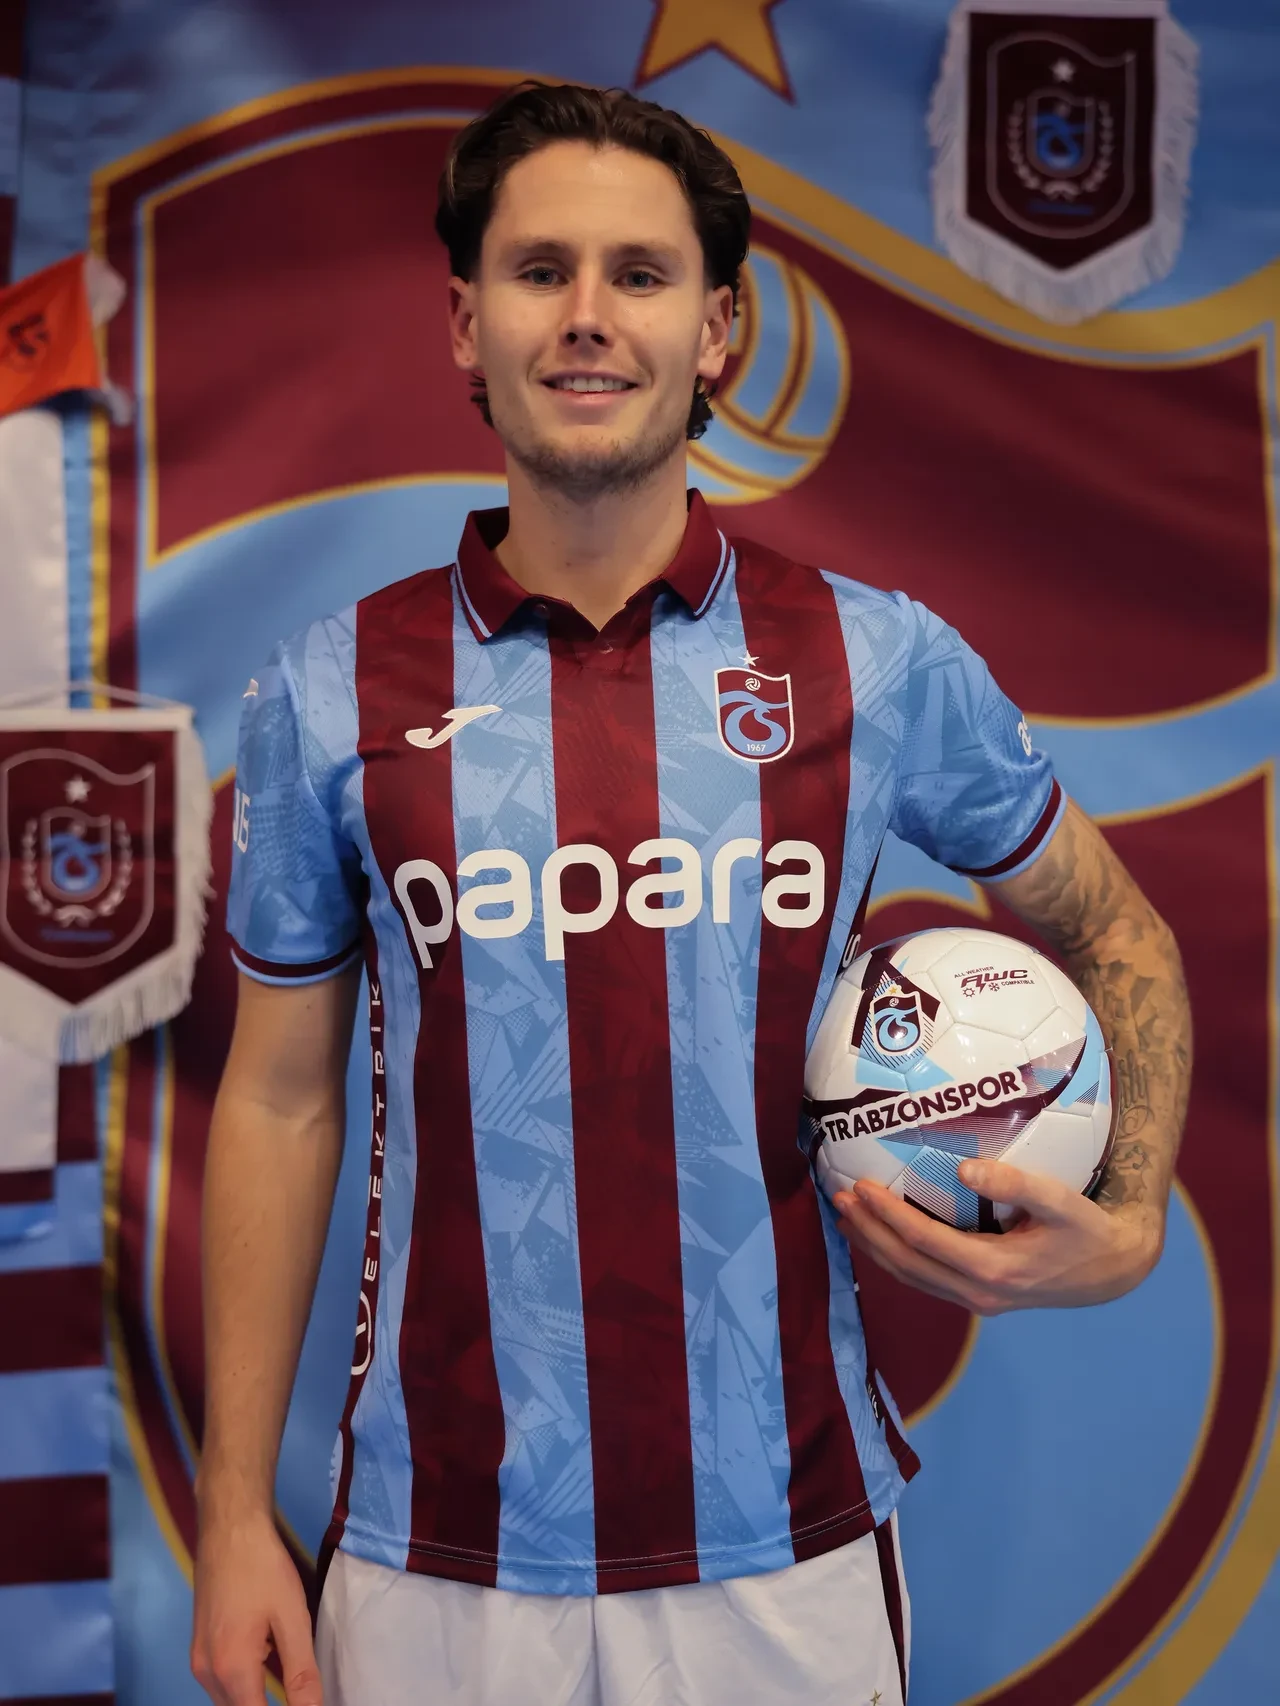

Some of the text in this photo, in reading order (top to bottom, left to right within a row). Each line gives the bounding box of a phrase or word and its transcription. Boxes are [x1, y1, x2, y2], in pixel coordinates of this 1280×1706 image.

[746, 743, 766, 752] 1967
[393, 837, 826, 969] papara
[966, 965, 995, 976] WEATHER
[960, 969, 1028, 989] AWC
[1000, 979, 1036, 987] COMPATIBLE
[825, 1070, 1021, 1143] TRABZONSPOR
